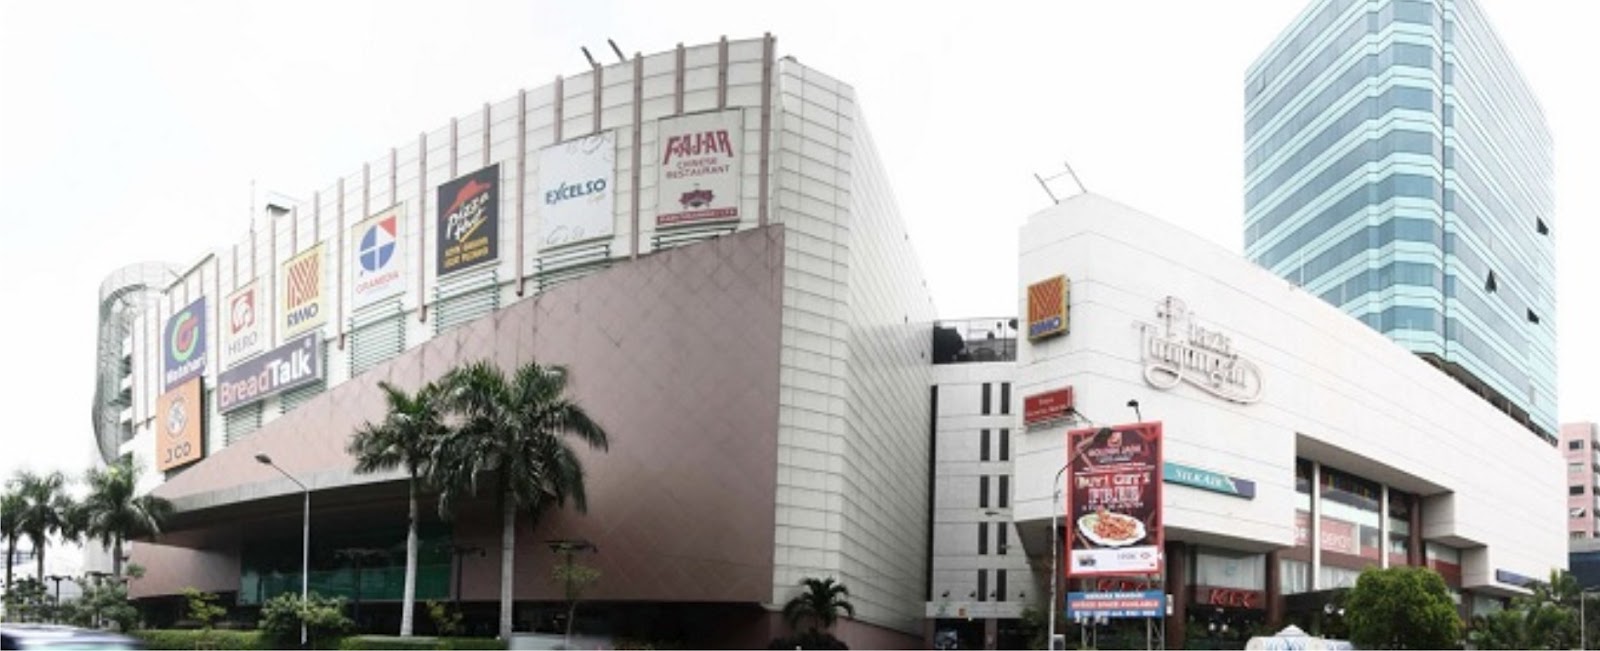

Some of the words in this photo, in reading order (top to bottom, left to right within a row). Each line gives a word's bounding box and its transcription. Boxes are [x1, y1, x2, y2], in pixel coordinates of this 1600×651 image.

[666, 164, 730, 179] RESTAURANT
[545, 178, 607, 205] EXCELSO
[287, 302, 319, 328] RIMO
[227, 331, 258, 356] HERO
[221, 348, 312, 407] BreadTalk
[1209, 588, 1256, 608] KFC
